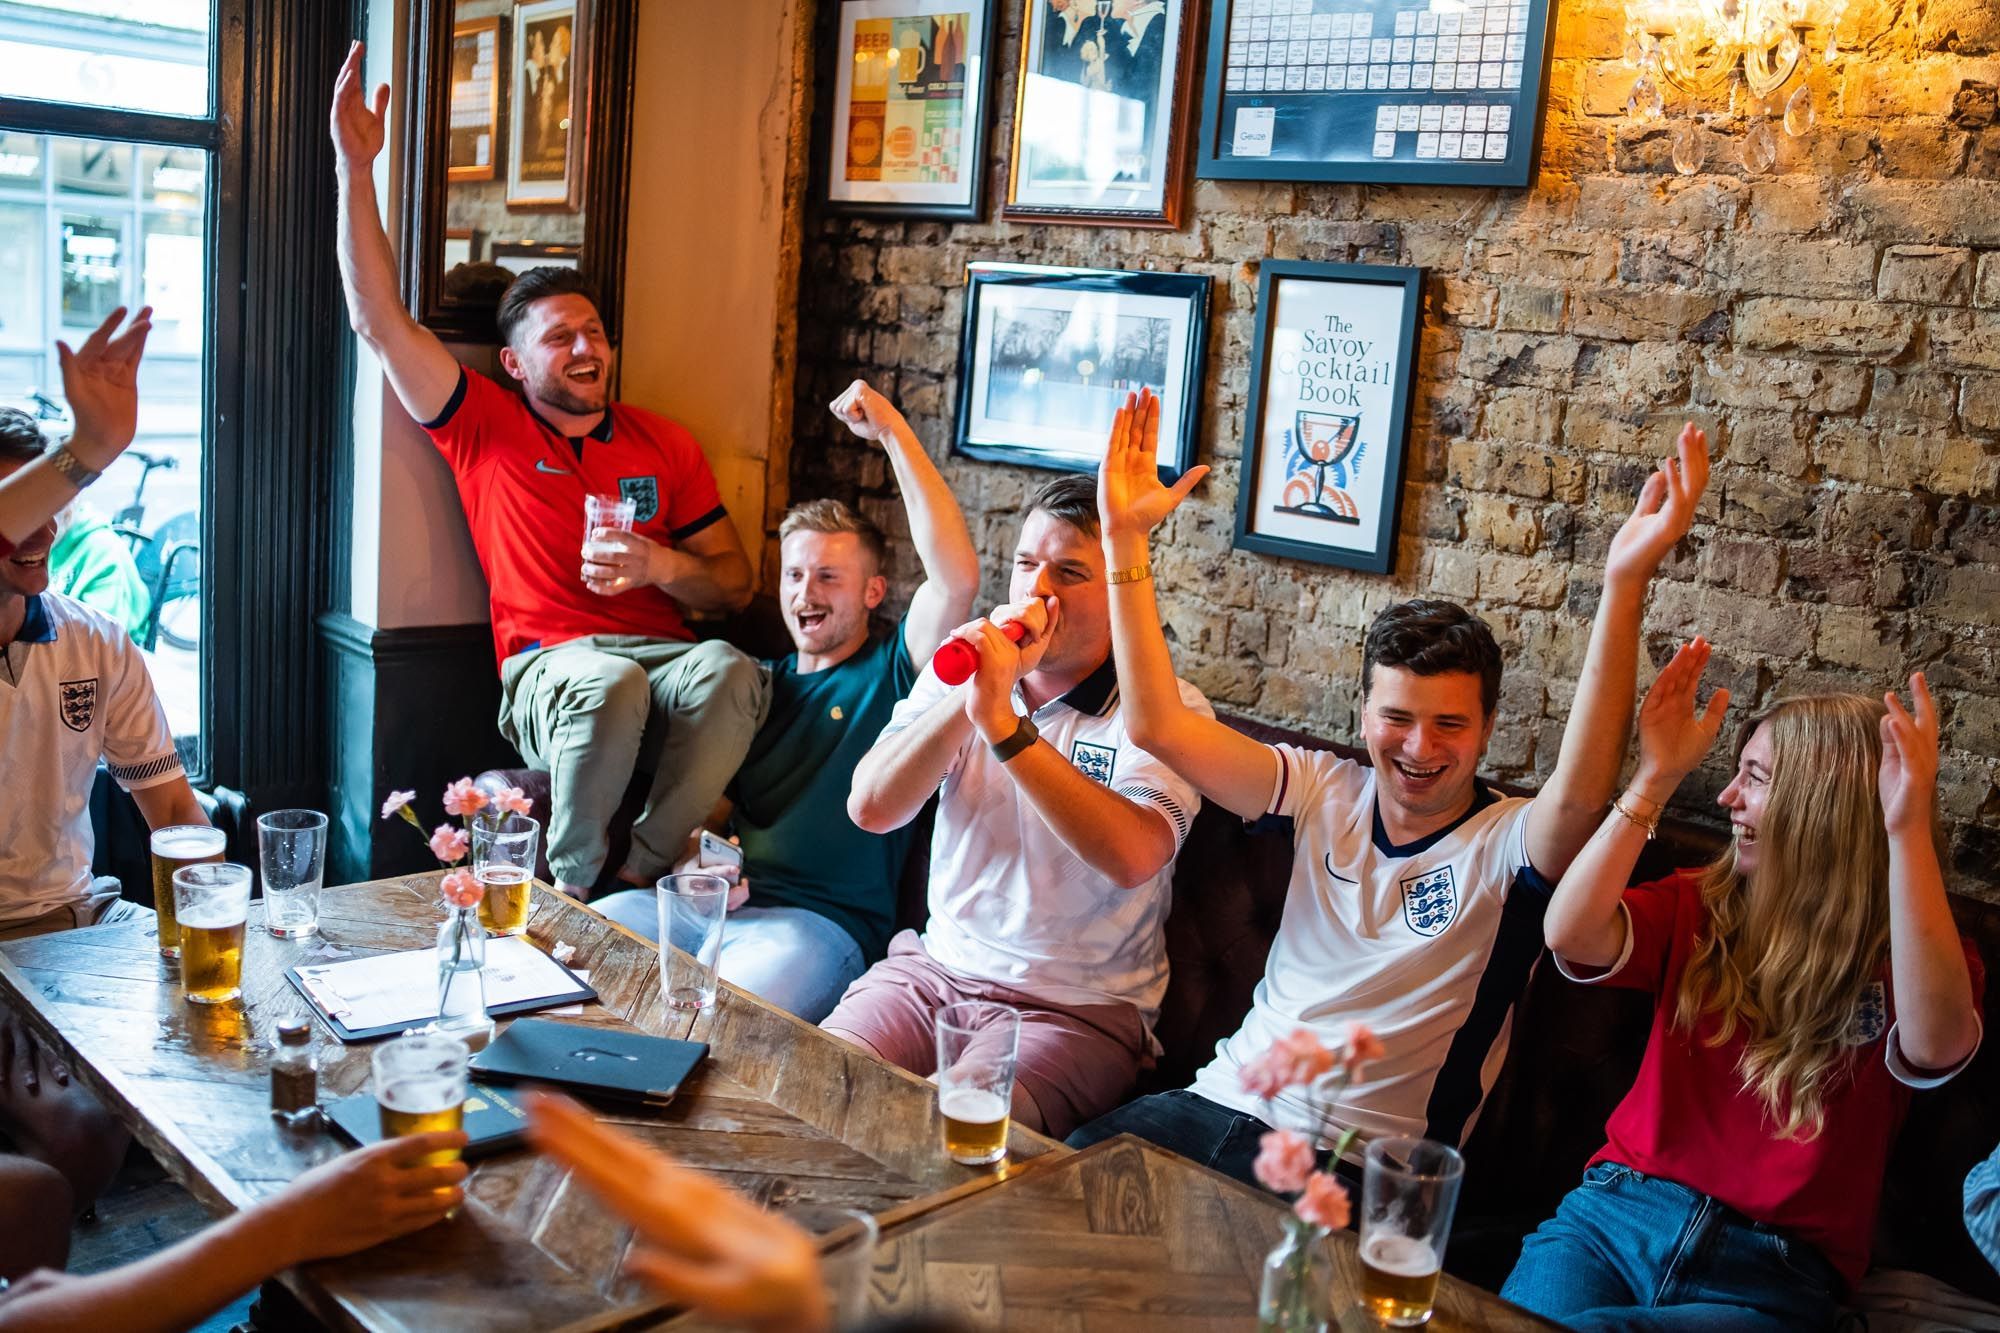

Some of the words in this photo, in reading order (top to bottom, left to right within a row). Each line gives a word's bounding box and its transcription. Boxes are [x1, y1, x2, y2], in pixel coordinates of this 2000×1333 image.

[1240, 131, 1267, 142] Geuze
[1325, 315, 1353, 333] The
[1302, 329, 1373, 362] Savoy
[1278, 350, 1390, 385] Cocktail
[1299, 377, 1361, 407] Book
